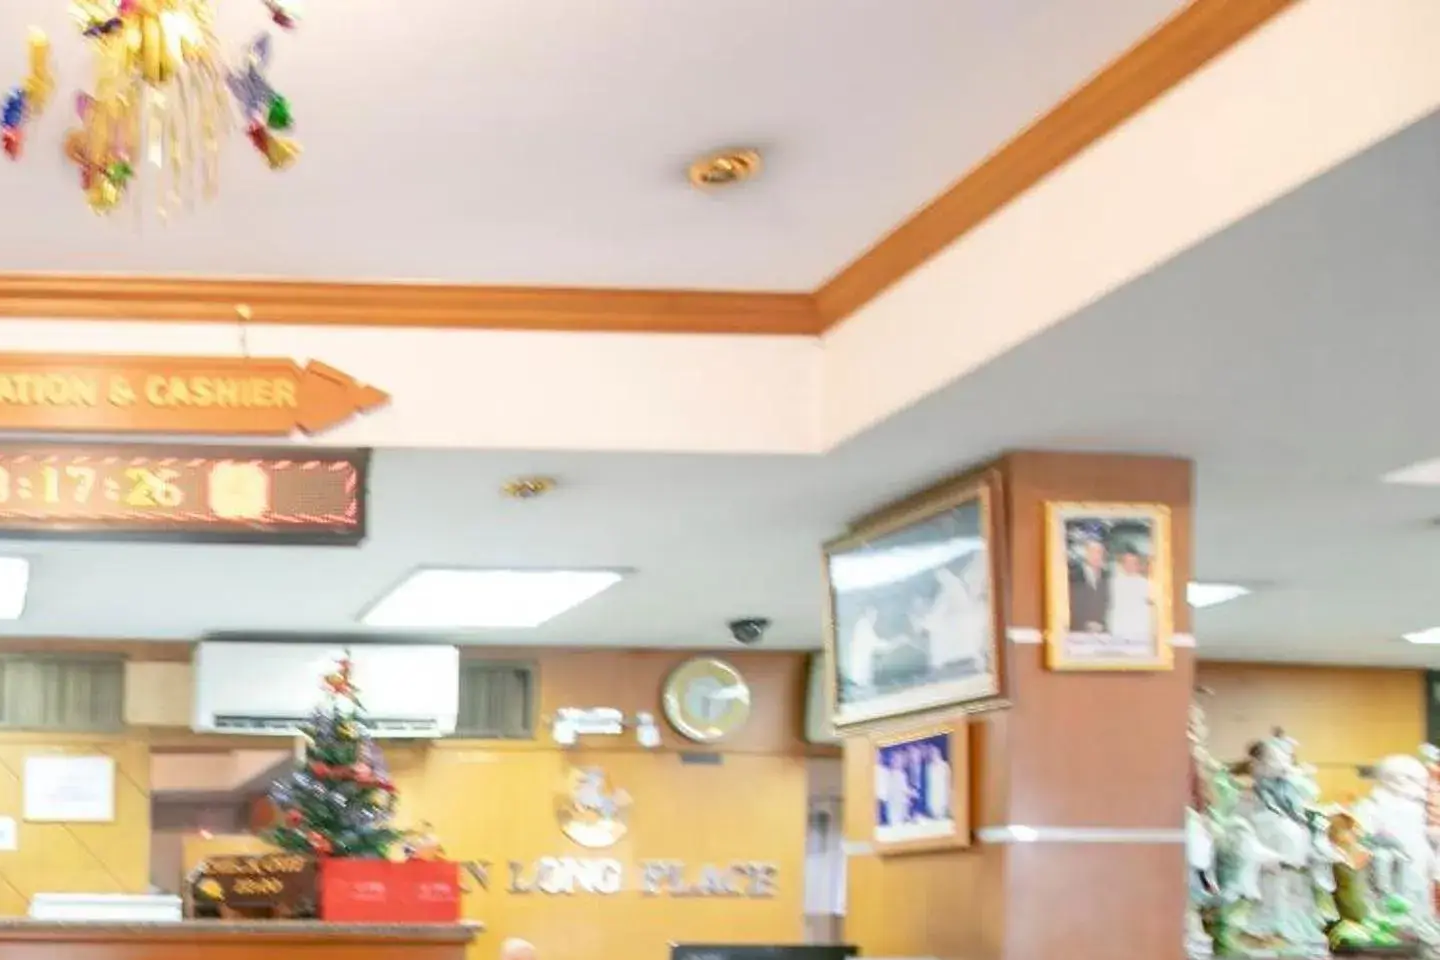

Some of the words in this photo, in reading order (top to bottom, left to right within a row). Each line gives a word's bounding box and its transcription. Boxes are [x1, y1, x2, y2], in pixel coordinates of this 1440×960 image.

[107, 377, 135, 405] &
[144, 376, 298, 408] CASHIER
[506, 856, 621, 894] LONG
[640, 859, 777, 898] PLACE
